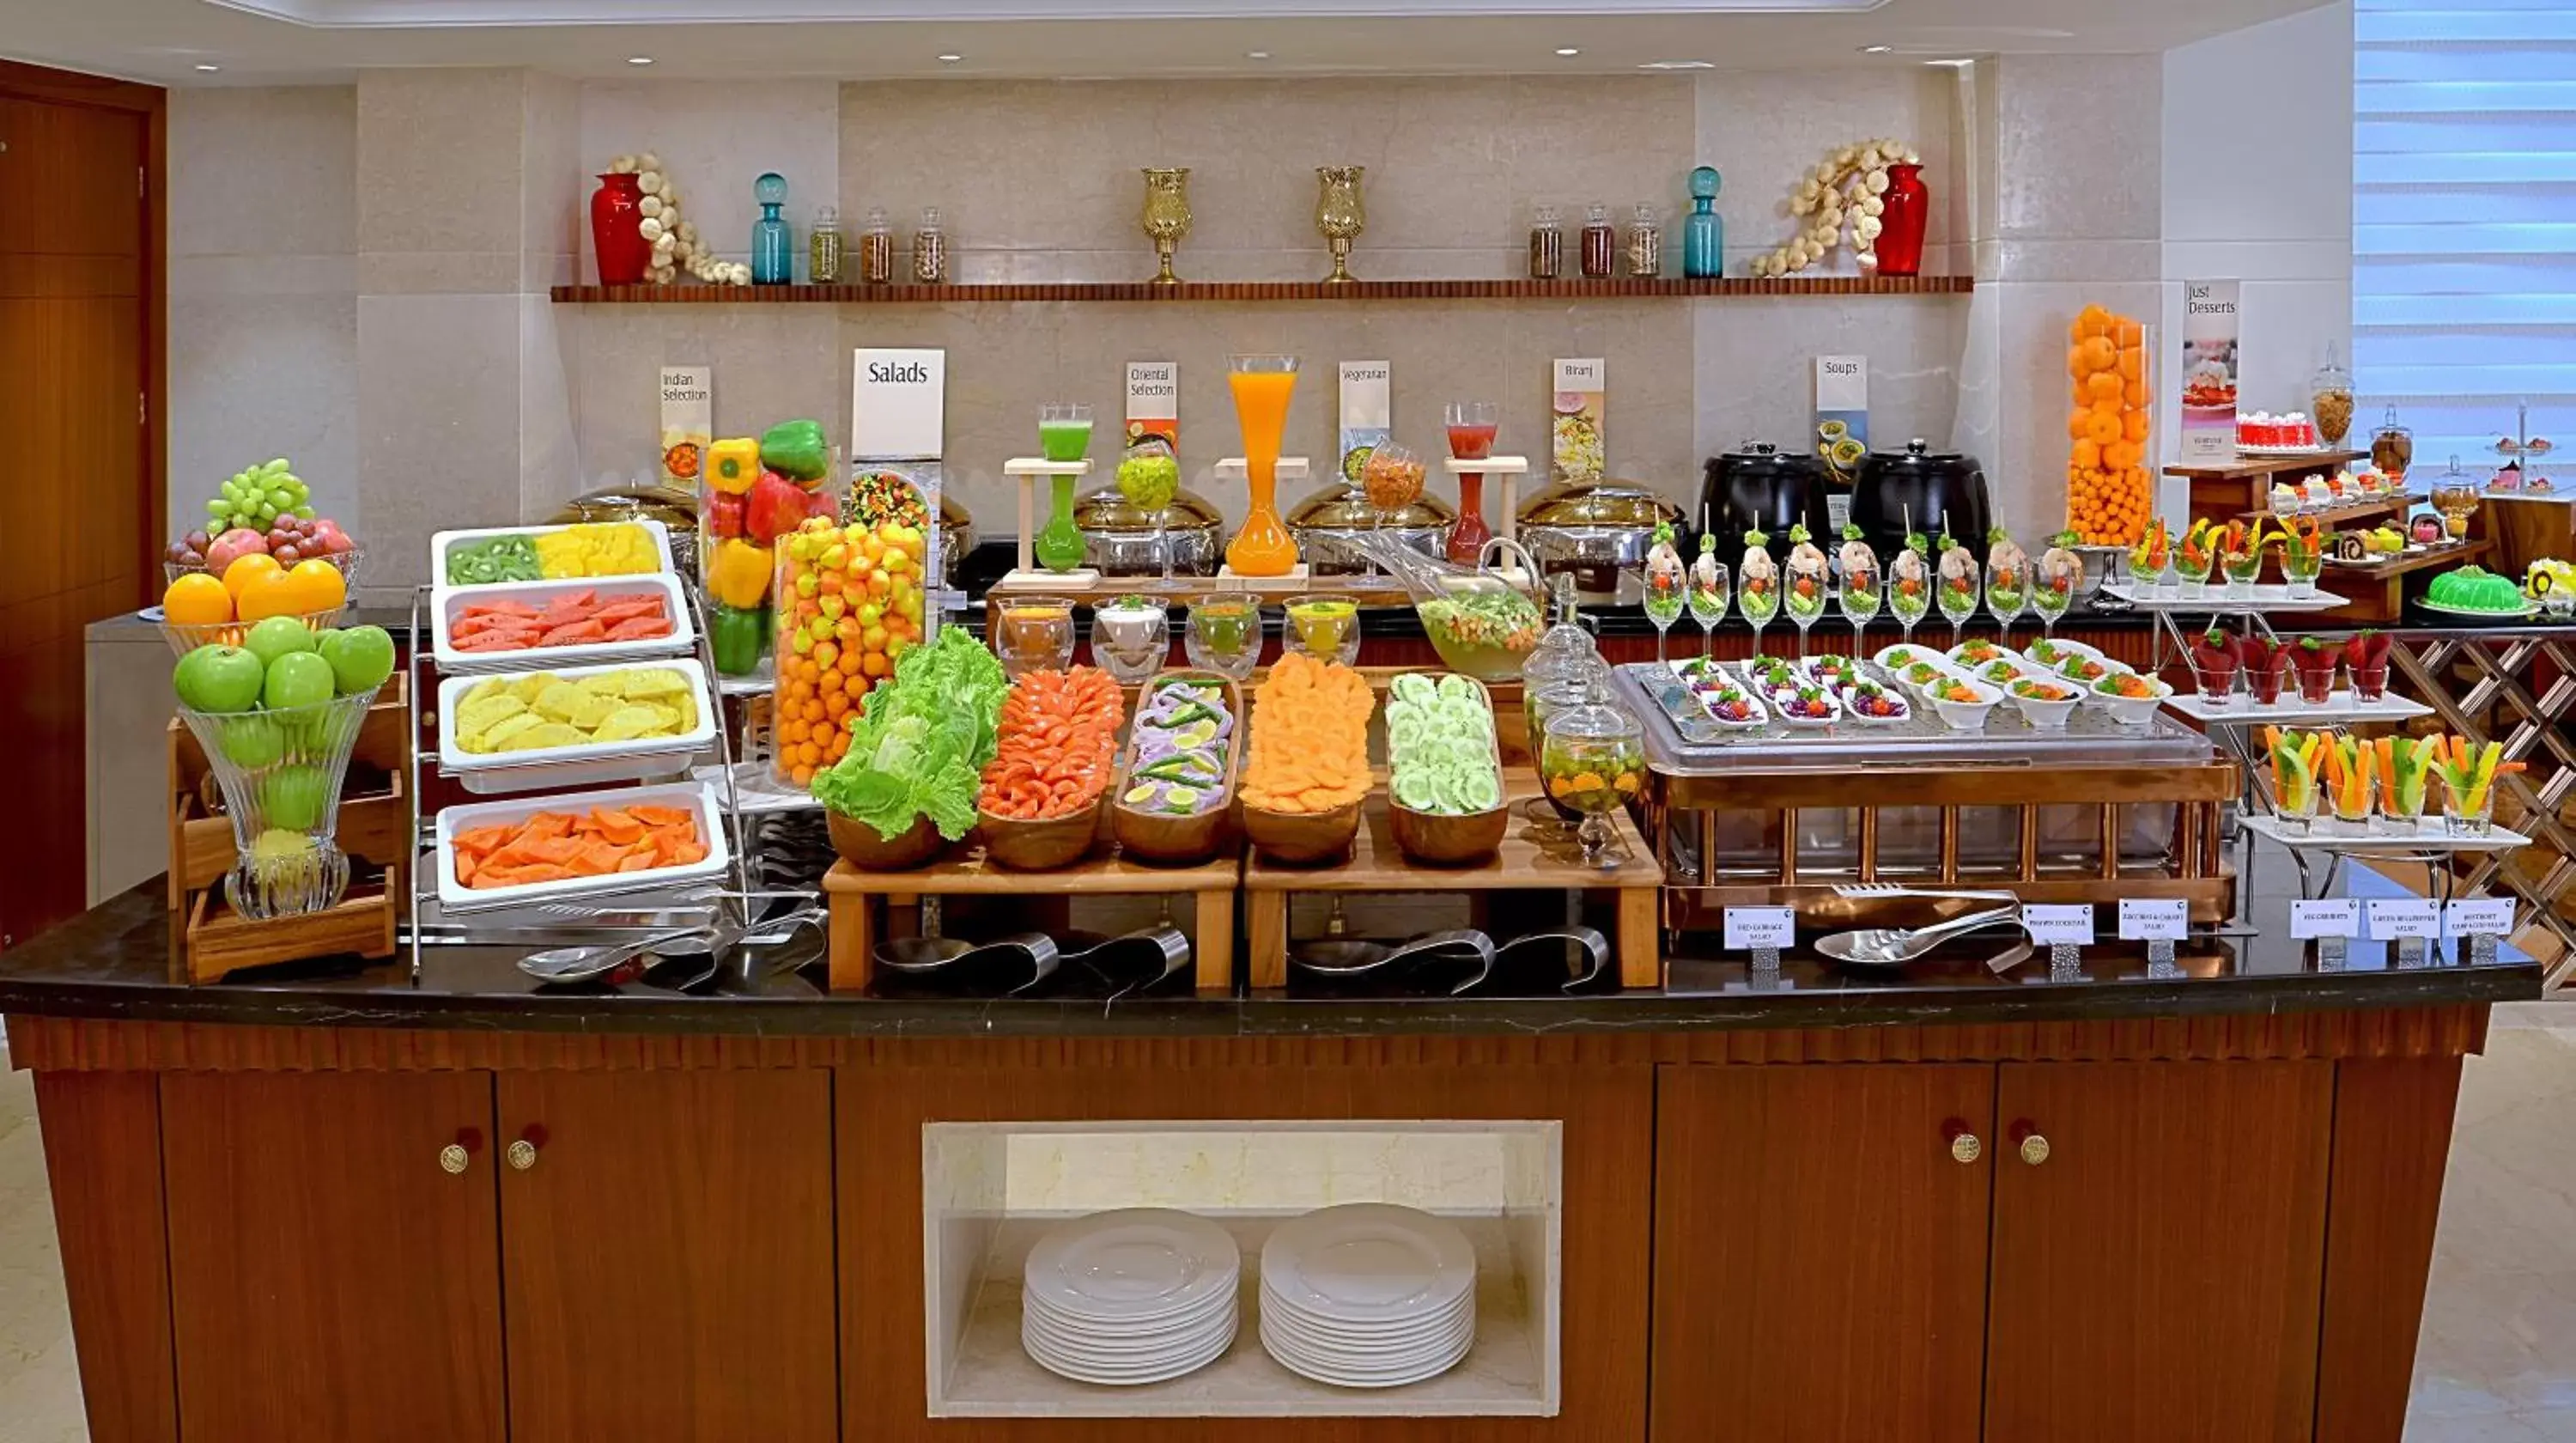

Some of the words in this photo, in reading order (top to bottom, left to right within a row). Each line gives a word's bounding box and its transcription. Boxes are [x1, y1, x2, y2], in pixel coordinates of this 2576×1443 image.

[2189, 285, 2209, 301] Just
[2189, 301, 2236, 314] Desserts
[867, 362, 927, 384] Salads
[1131, 368, 1169, 381] Oriental
[1826, 362, 1858, 375] Soups
[663, 373, 694, 386] Indian
[663, 388, 708, 401] Selection
[1131, 383, 1175, 396] Selection
